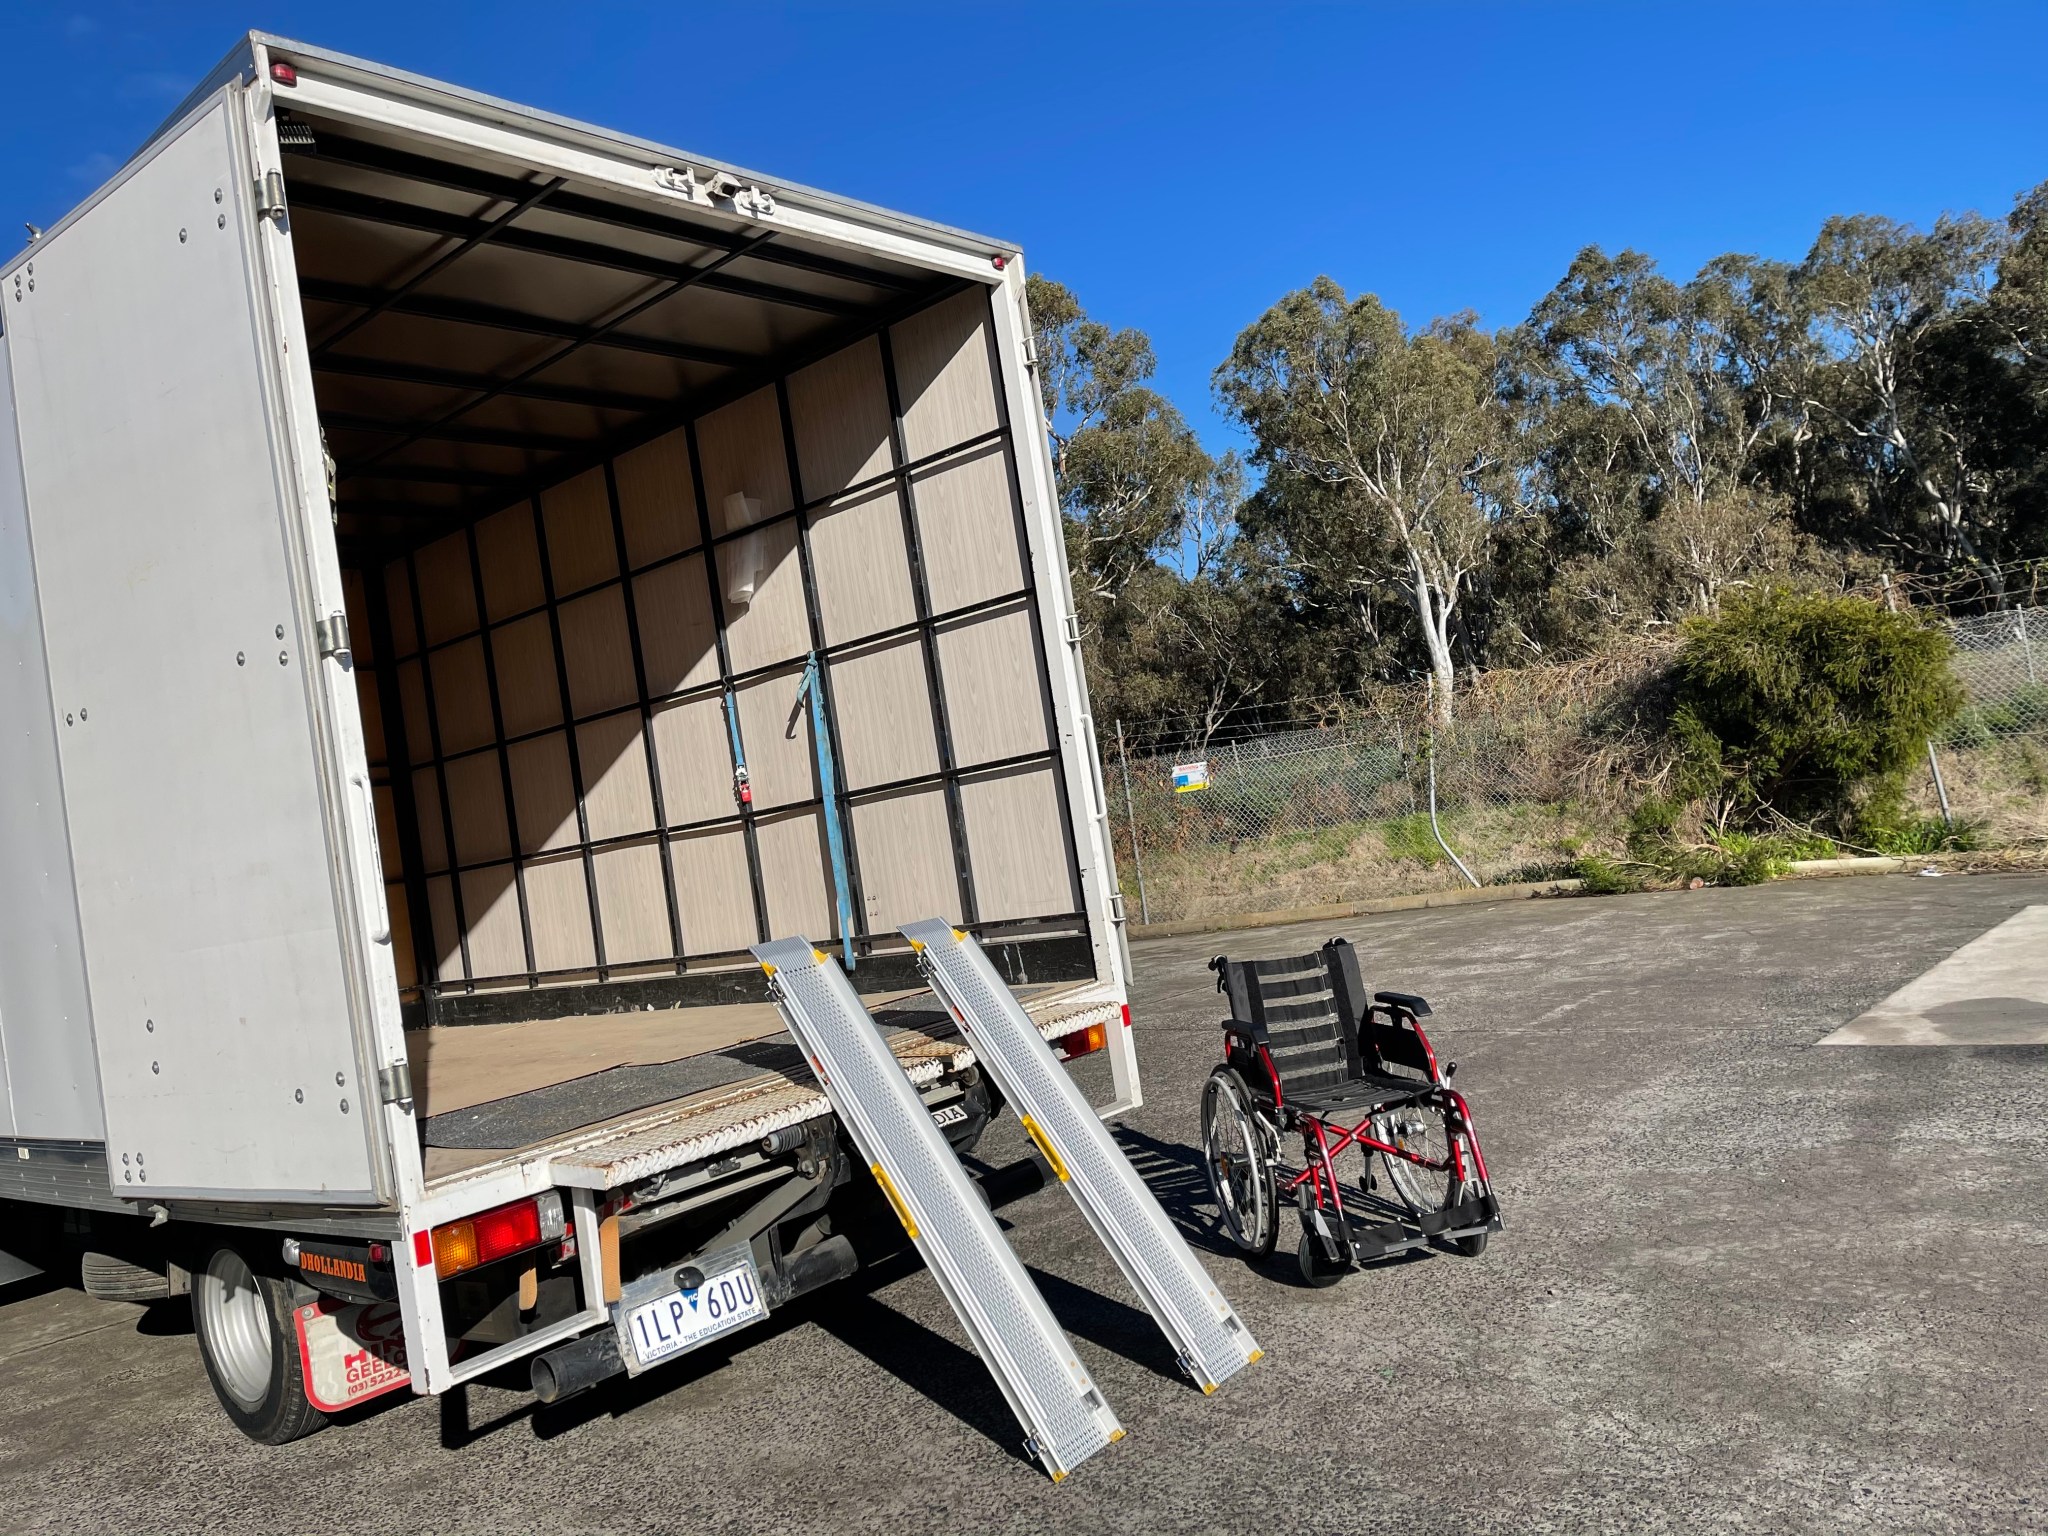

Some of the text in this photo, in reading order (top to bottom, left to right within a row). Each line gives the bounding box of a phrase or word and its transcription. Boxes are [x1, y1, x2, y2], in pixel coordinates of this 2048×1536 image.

[300, 1252, 366, 1283] DHOLLANDIA
[637, 1273, 754, 1348] 1LP 6DU
[644, 1341, 678, 1360] VICTORIA
[684, 1332, 698, 1343] THE
[699, 1317, 737, 1335] EDUCATION
[737, 1307, 756, 1321] STATE
[344, 1338, 406, 1368] HIN
[348, 1382, 368, 1396] (03)
